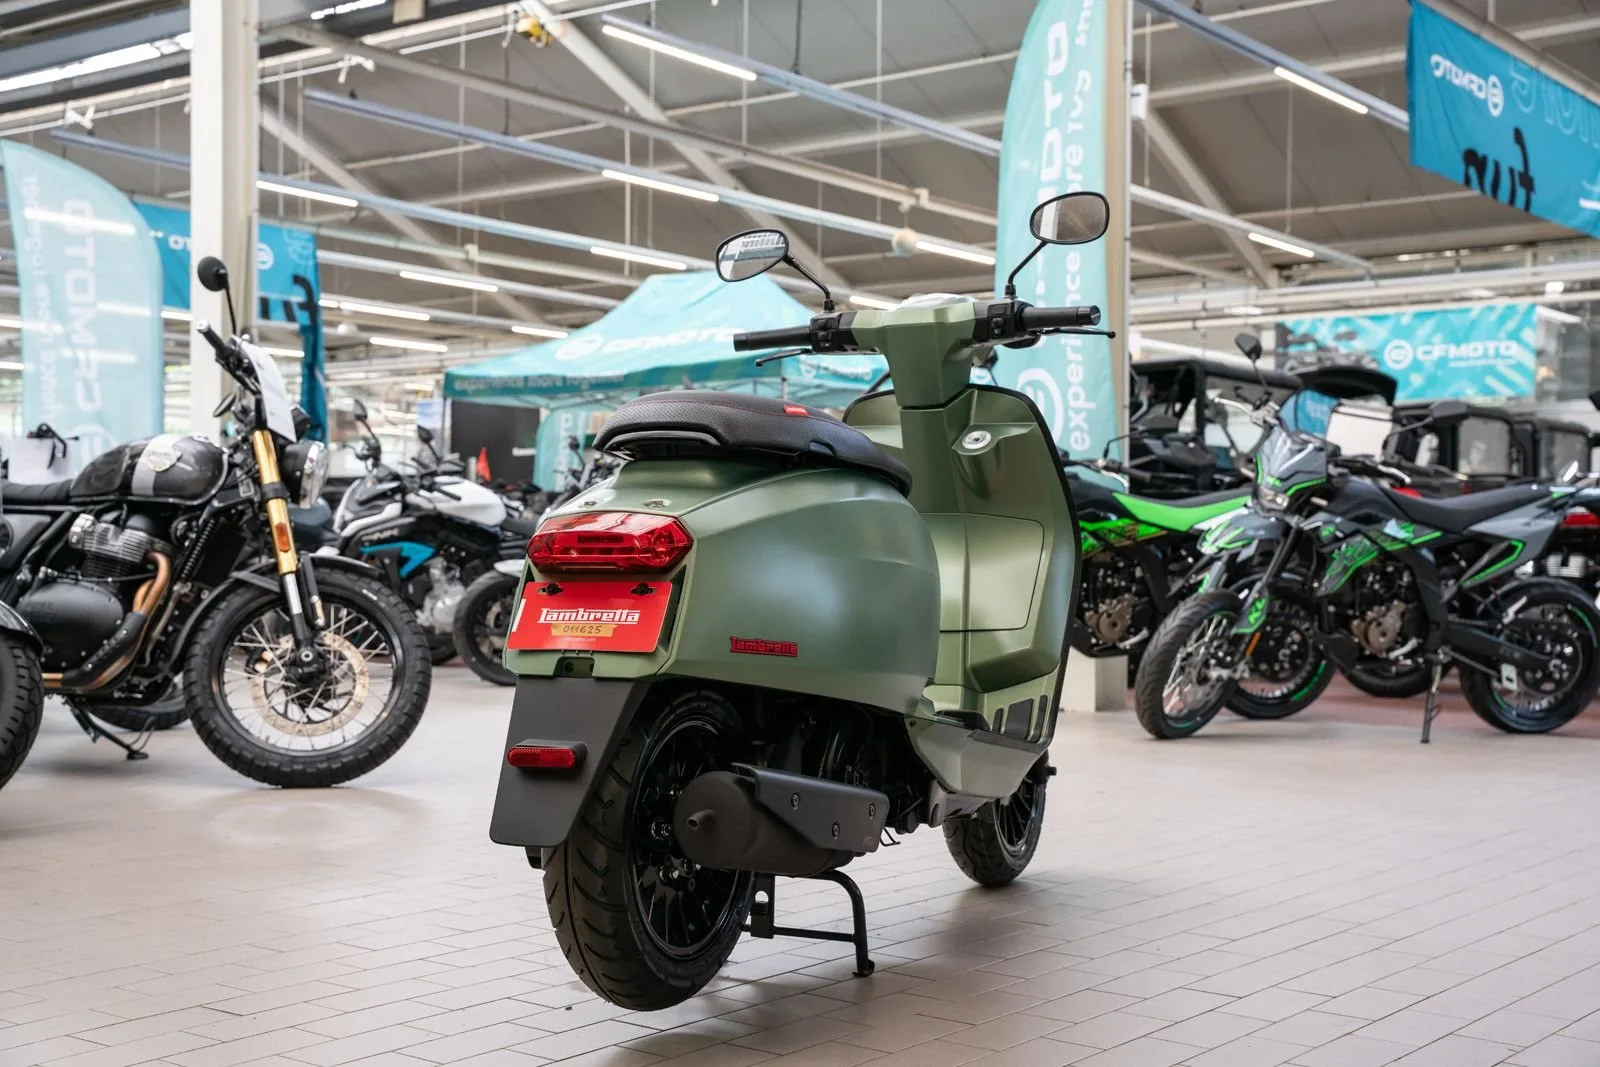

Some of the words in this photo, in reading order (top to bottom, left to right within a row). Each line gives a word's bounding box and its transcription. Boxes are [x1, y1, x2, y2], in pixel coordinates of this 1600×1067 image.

[1060, 251, 1097, 451] experince
[1416, 341, 1517, 361] CFMOTO
[537, 608, 640, 624] Lambretta
